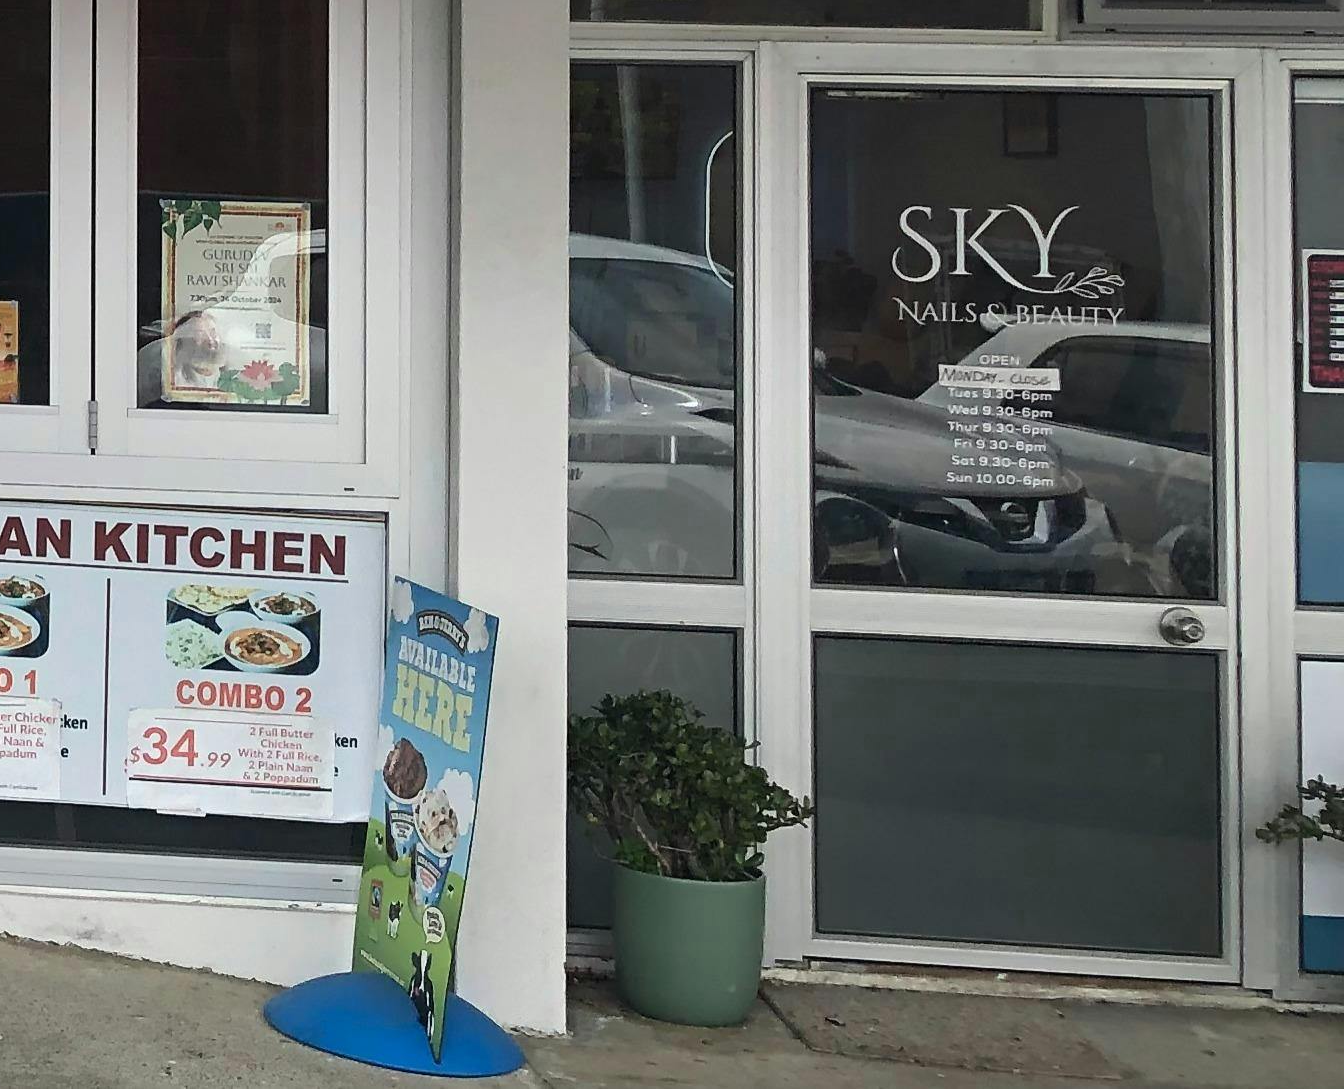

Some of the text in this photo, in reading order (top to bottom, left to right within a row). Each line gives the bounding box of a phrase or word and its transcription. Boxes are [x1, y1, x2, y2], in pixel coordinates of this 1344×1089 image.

[203, 249, 268, 261] GURUDV
[891, 203, 1080, 294] SKY
[214, 262, 234, 274] SRI
[187, 274, 287, 288] RAVI SHANKAR
[892, 297, 1126, 328] NAILS & BEAUTY
[979, 355, 1020, 366] OPEN
[947, 388, 978, 399] Tues
[947, 405, 979, 416] Wed
[947, 421, 979, 433] Thur
[953, 438, 973, 449] Fri
[951, 455, 976, 466] Sat
[946, 471, 973, 483] Sun
[93, 520, 347, 576] KITCHEN
[399, 635, 476, 693] AVAILABLE
[24, 670, 37, 695] 1
[176, 679, 312, 713] COMBO 2
[392, 662, 473, 753] HERE
[20, 724, 47, 737] Rice,
[249, 726, 314, 740] 2 Full Butter
[4, 736, 33, 747] Naan
[35, 738, 45, 748] &
[129, 726, 232, 768] $34.99
[260, 739, 303, 750] Chicken
[238, 748, 323, 763] With 2 Full Rice,
[248, 760, 313, 773] 2 Plain Naan
[243, 771, 319, 785] & 2 Poppadum
